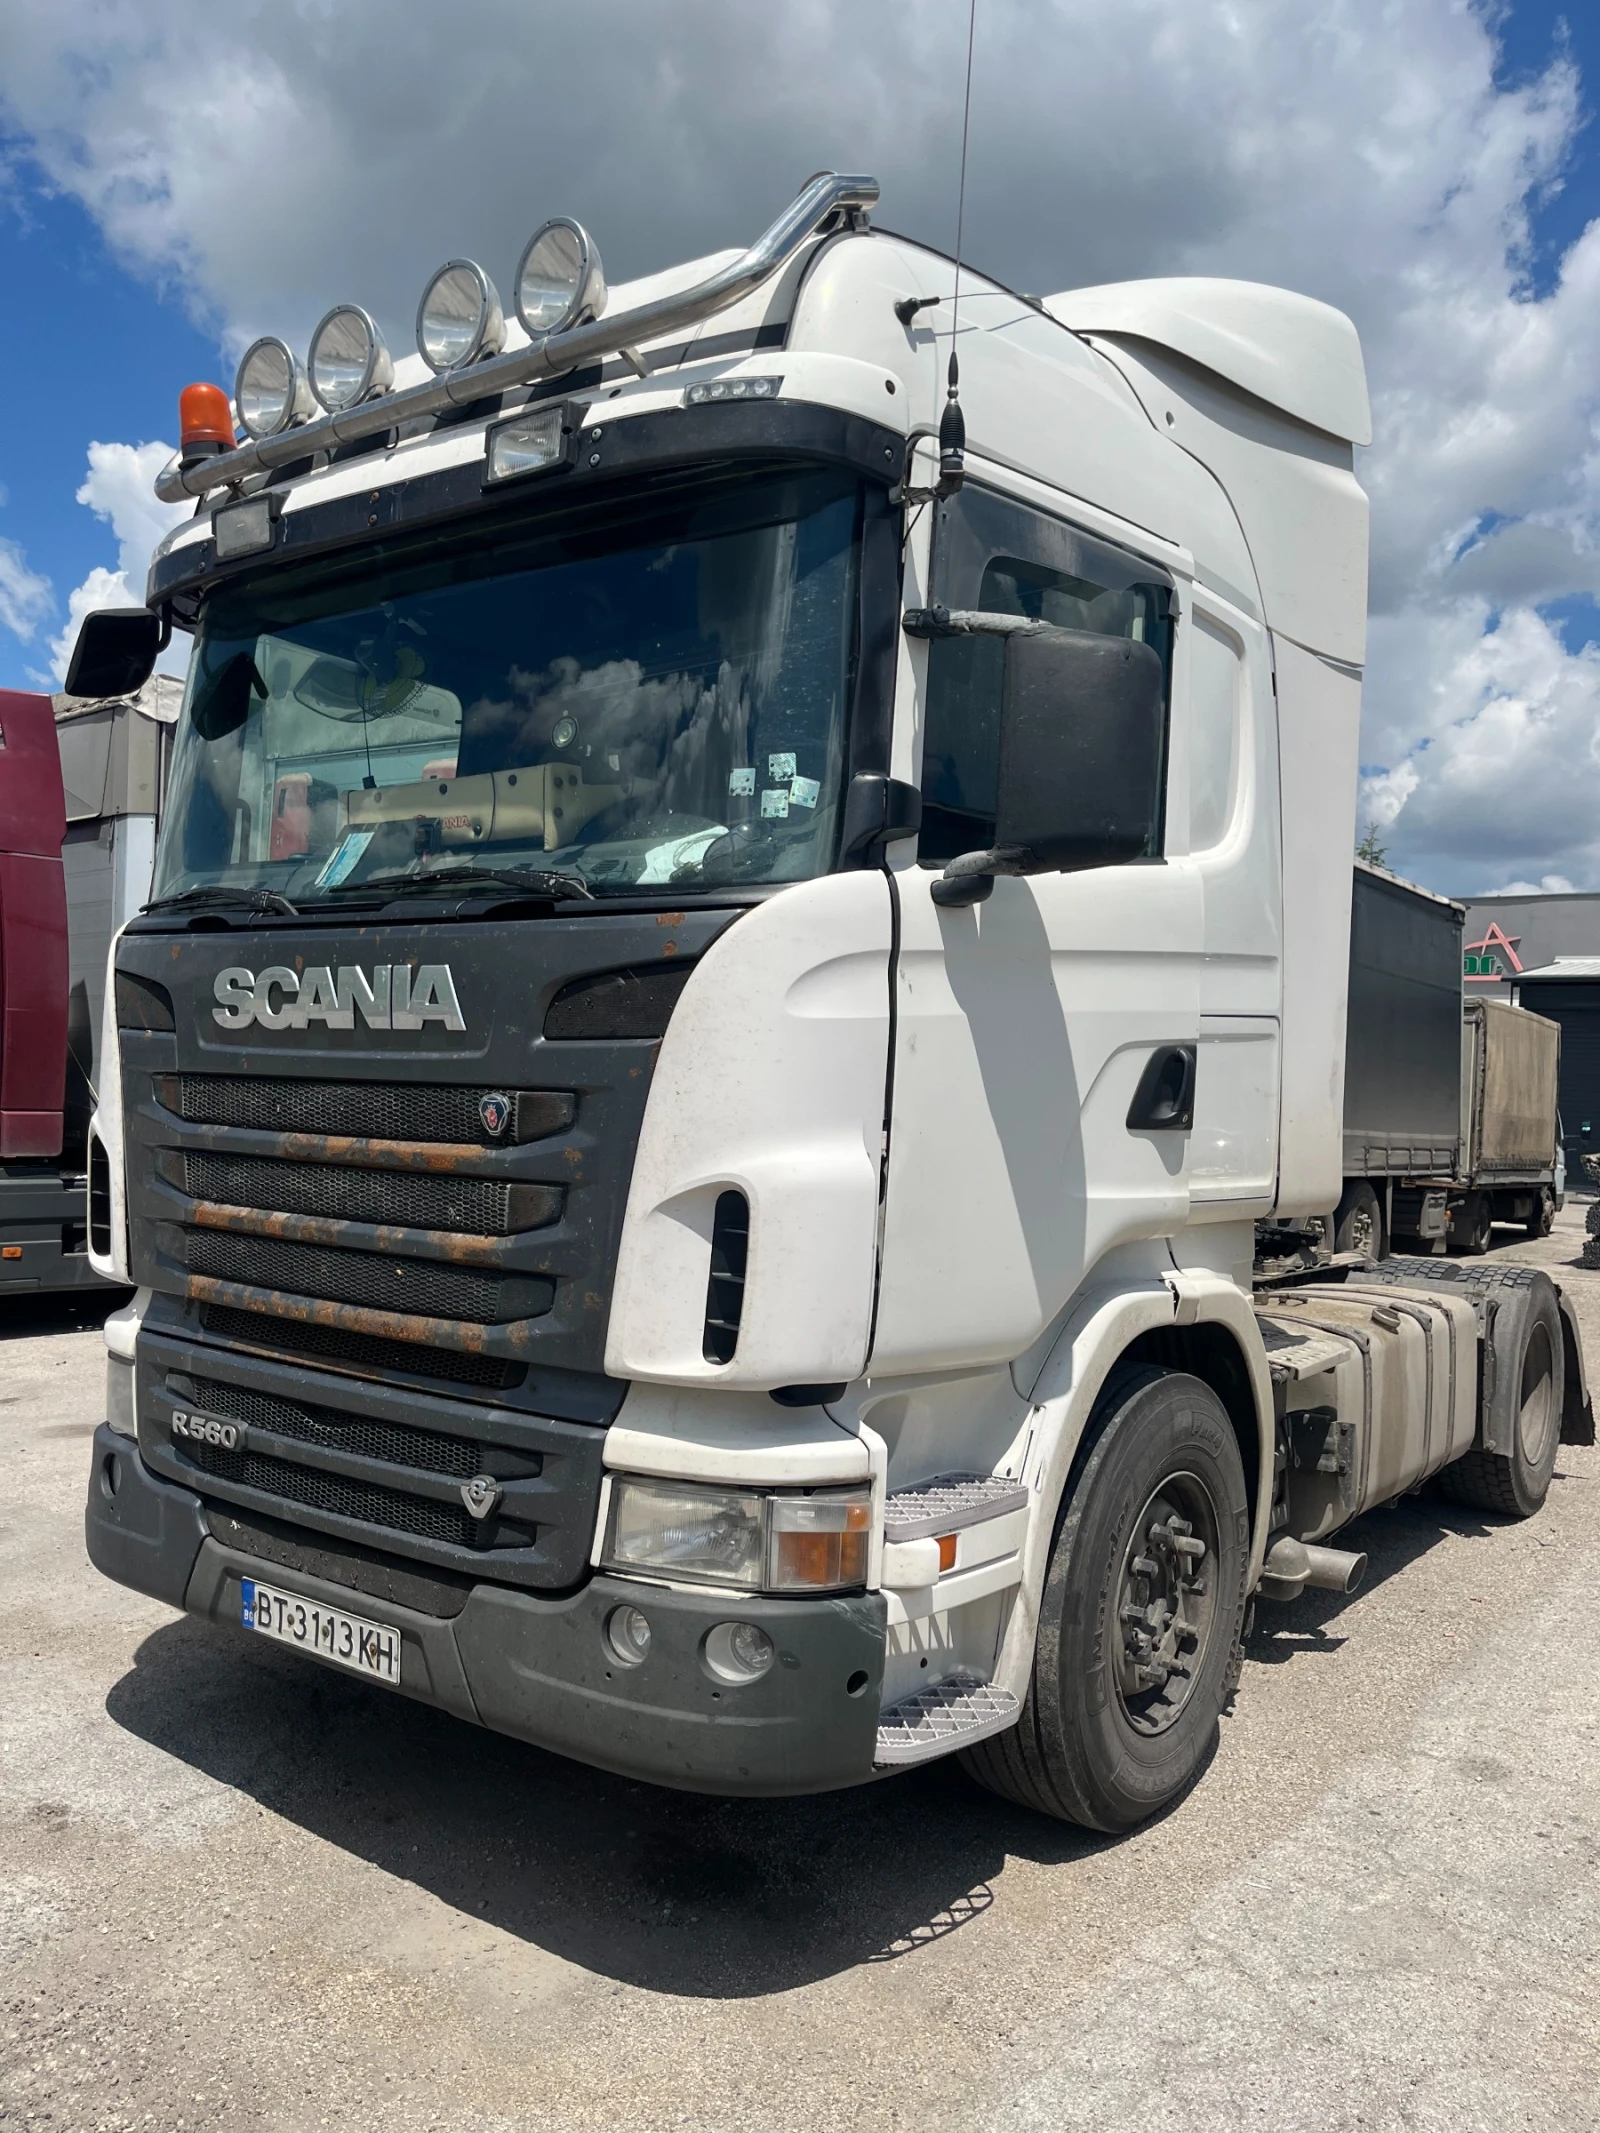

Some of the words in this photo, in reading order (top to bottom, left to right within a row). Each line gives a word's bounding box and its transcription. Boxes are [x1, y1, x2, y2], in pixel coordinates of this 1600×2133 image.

[212, 963, 467, 1032] SCANIA
[243, 1608, 255, 1622] BG
[257, 1590, 393, 1676] BT3113KH
